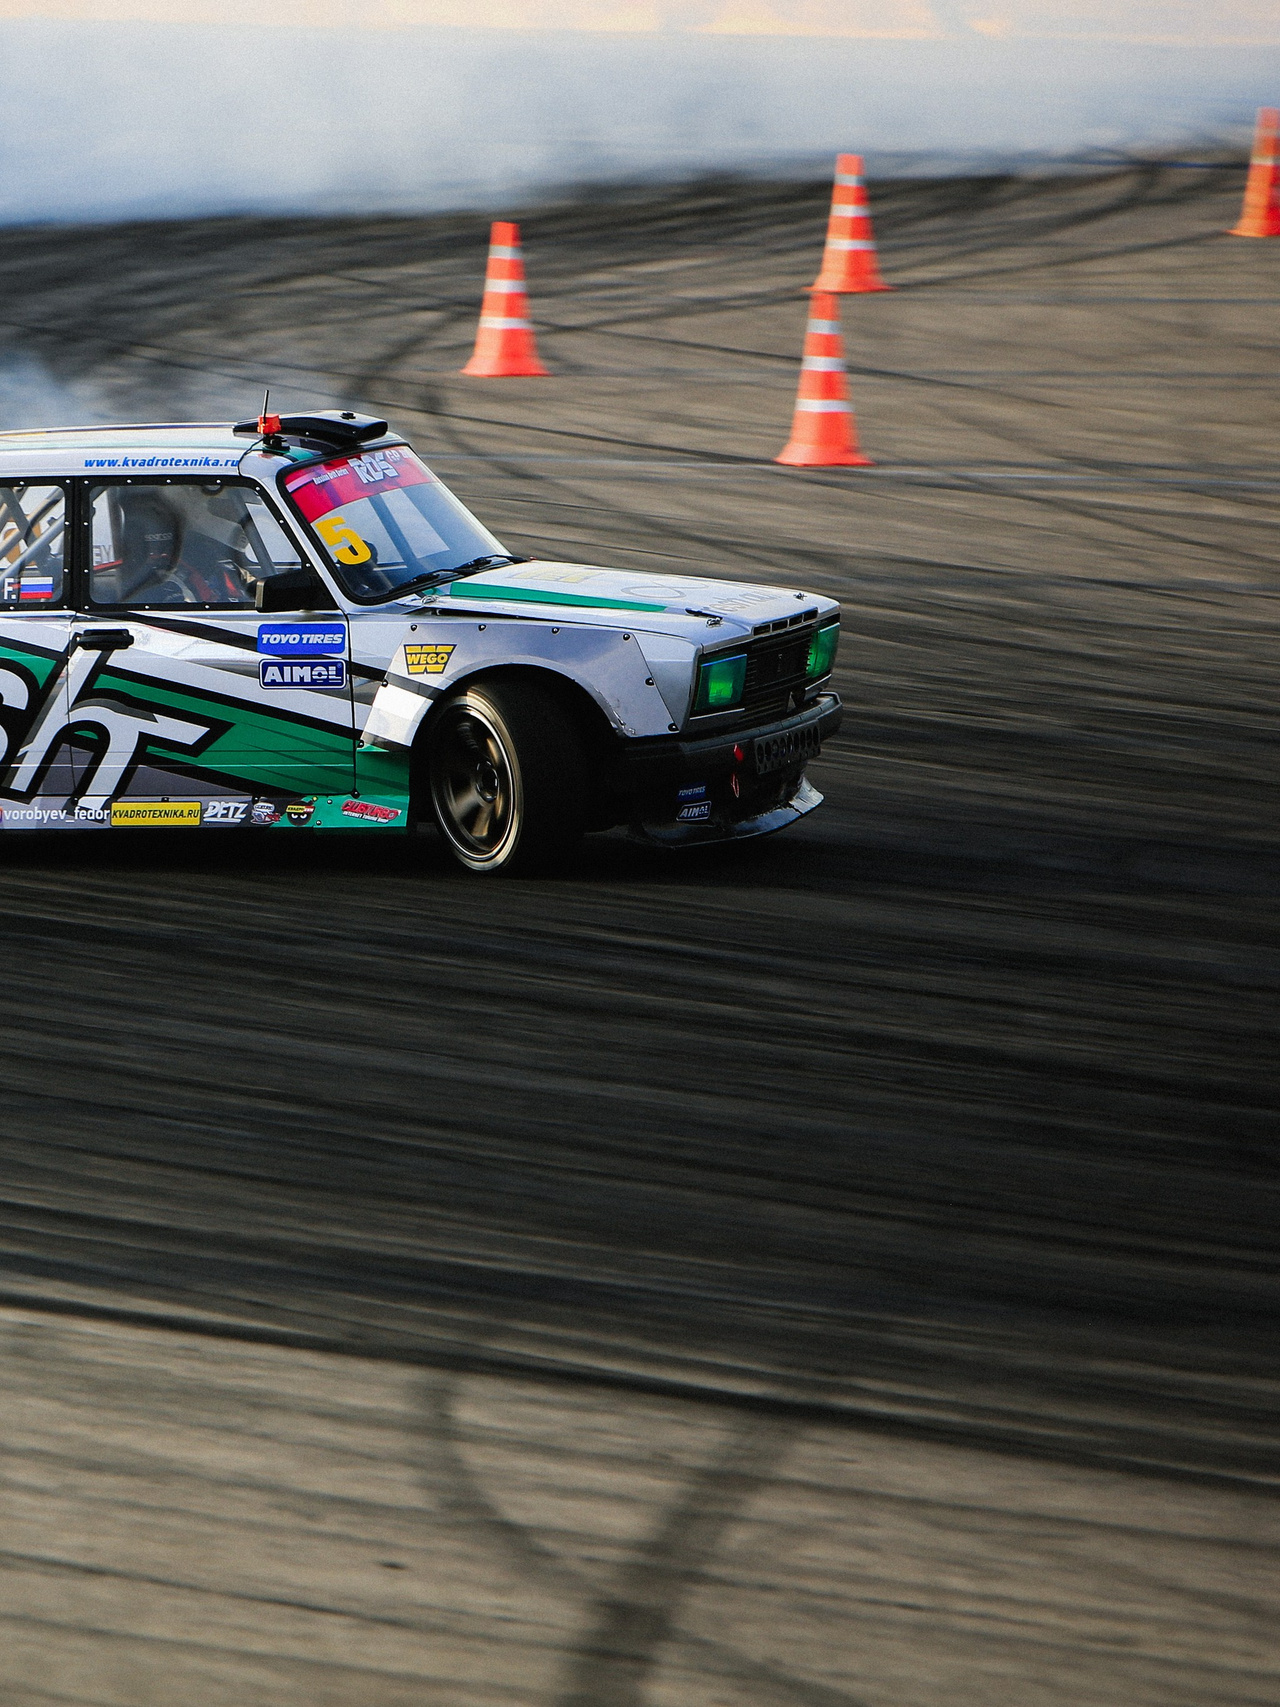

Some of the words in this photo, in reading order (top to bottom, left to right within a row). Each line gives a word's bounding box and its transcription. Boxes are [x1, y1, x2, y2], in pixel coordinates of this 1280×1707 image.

[83, 456, 240, 468] www.kvadrotexnika.ru
[347, 453, 399, 484] RDS
[315, 516, 372, 565] 5
[3, 577, 17, 600] F.
[261, 633, 299, 645] TOYO
[301, 633, 344, 645] TIRES
[406, 652, 450, 665] WEGO
[263, 665, 343, 683] AIMOL
[4, 806, 111, 823] vorobyev_fedor
[111, 808, 200, 820] KVADROTEXNIKA.RU
[679, 805, 709, 818] AIMOL
